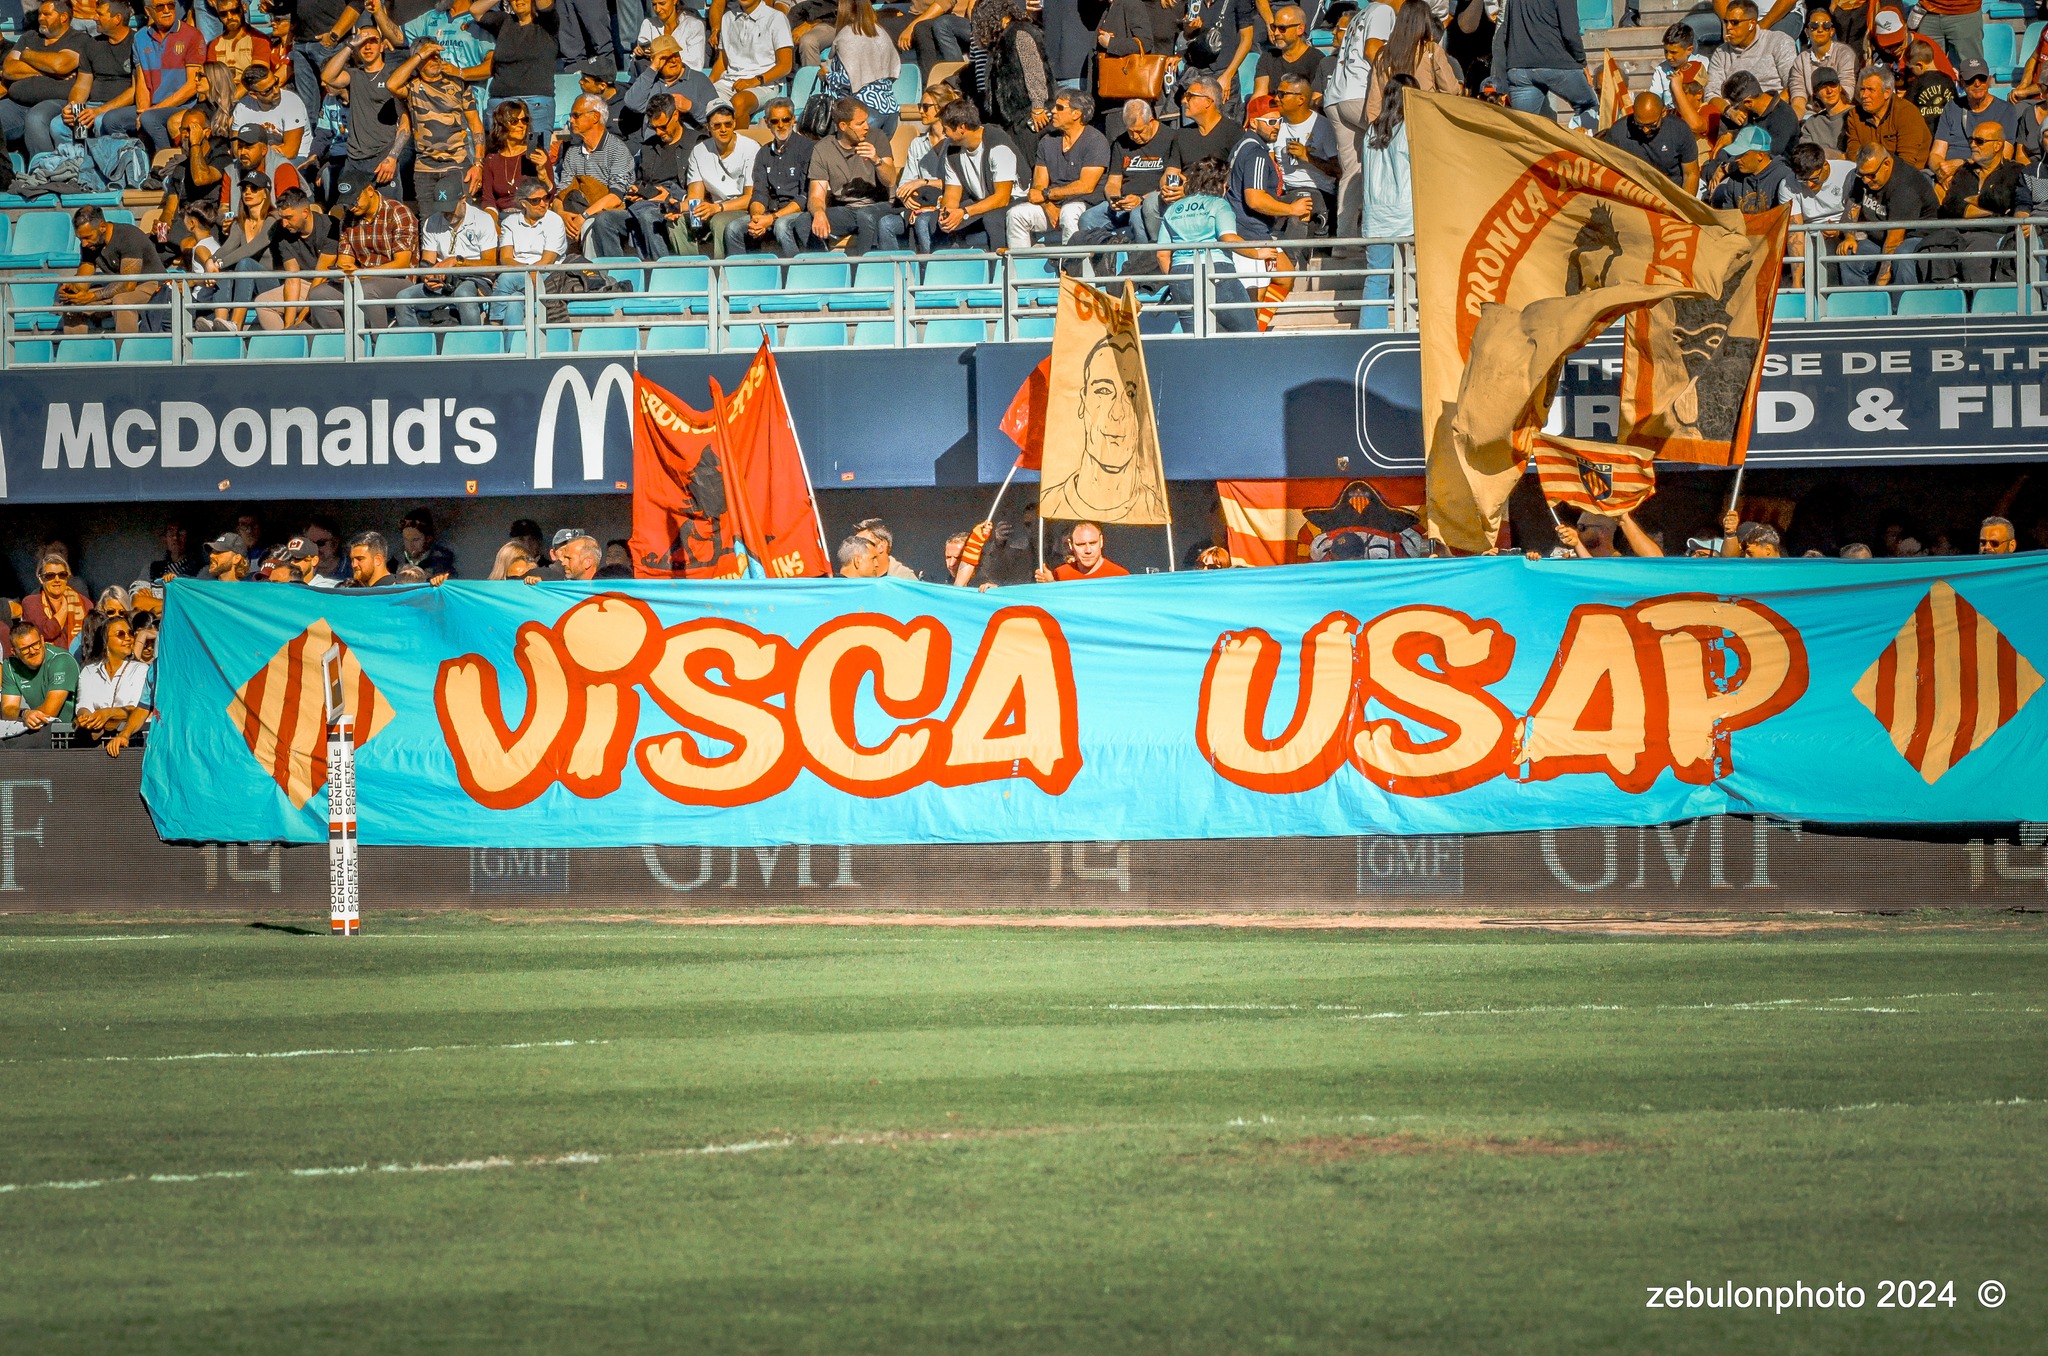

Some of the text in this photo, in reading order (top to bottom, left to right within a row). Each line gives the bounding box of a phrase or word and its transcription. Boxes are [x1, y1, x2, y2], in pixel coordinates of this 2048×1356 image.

[1129, 155, 1163, 168] Element
[1184, 202, 1205, 212] JOA
[1842, 351, 1912, 374] DE
[42, 397, 498, 470] McDonald's
[1195, 592, 1810, 797] USAP
[334, 748, 342, 816] GENERALE
[336, 846, 344, 913] GENERALE
[1369, 837, 1454, 877] GMF
